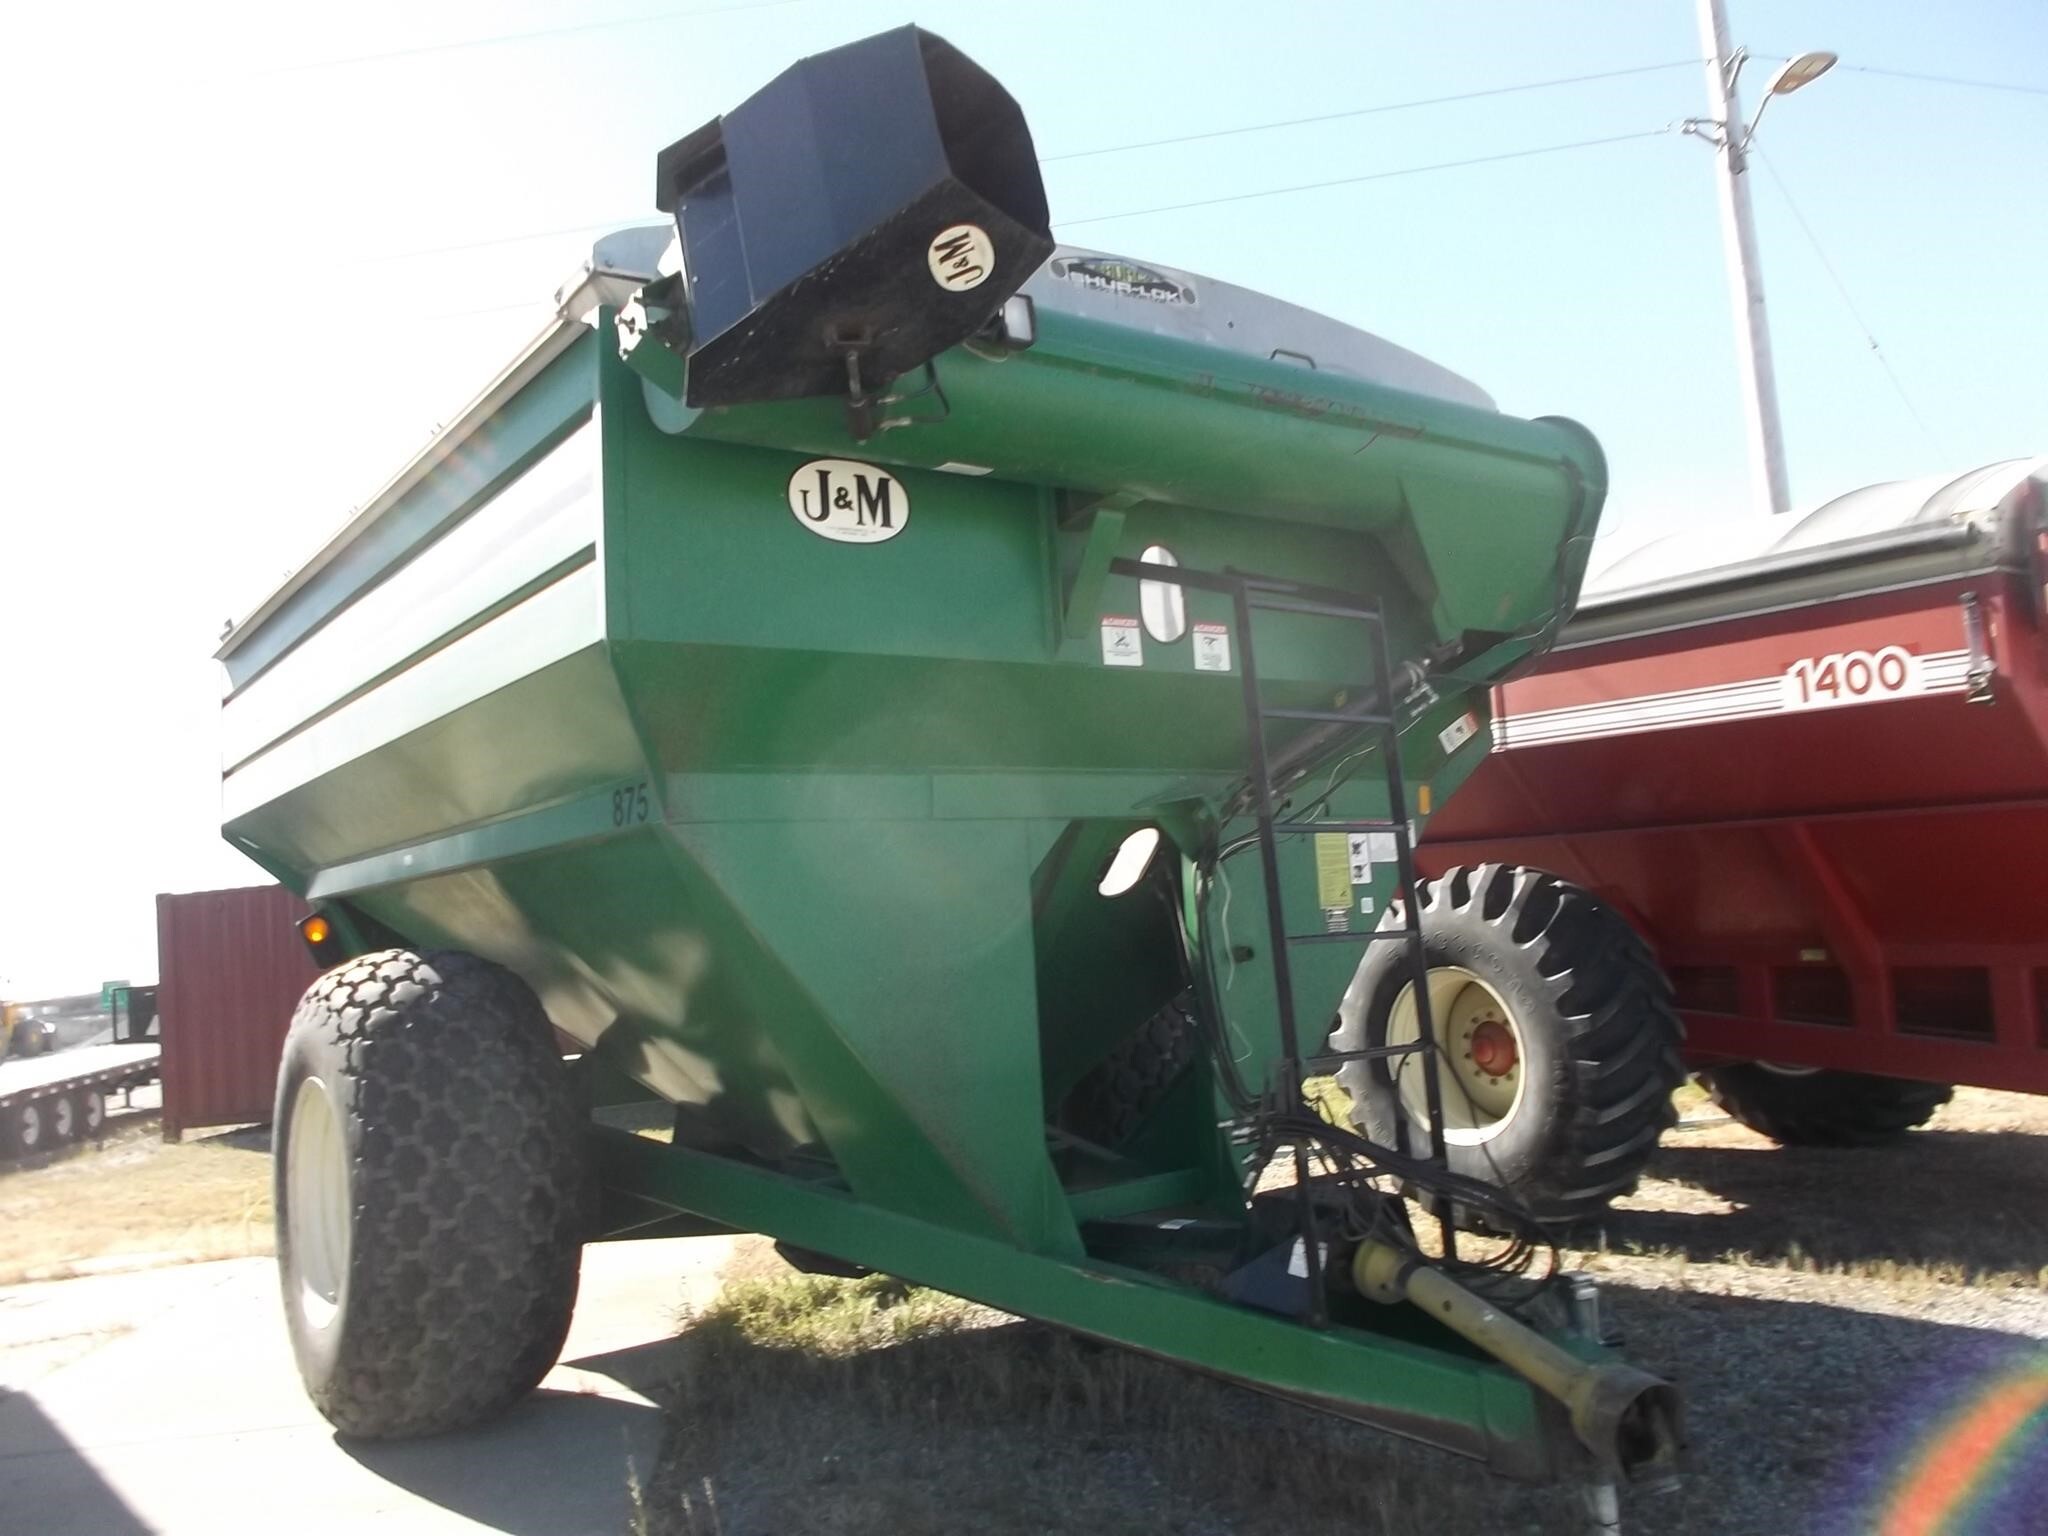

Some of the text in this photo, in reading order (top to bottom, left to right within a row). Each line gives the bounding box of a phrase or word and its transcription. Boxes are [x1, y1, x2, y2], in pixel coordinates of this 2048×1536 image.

[933, 231, 984, 284] J&M
[799, 469, 894, 528] J&M
[1795, 653, 1907, 703] 1400
[612, 782, 649, 828] 875
